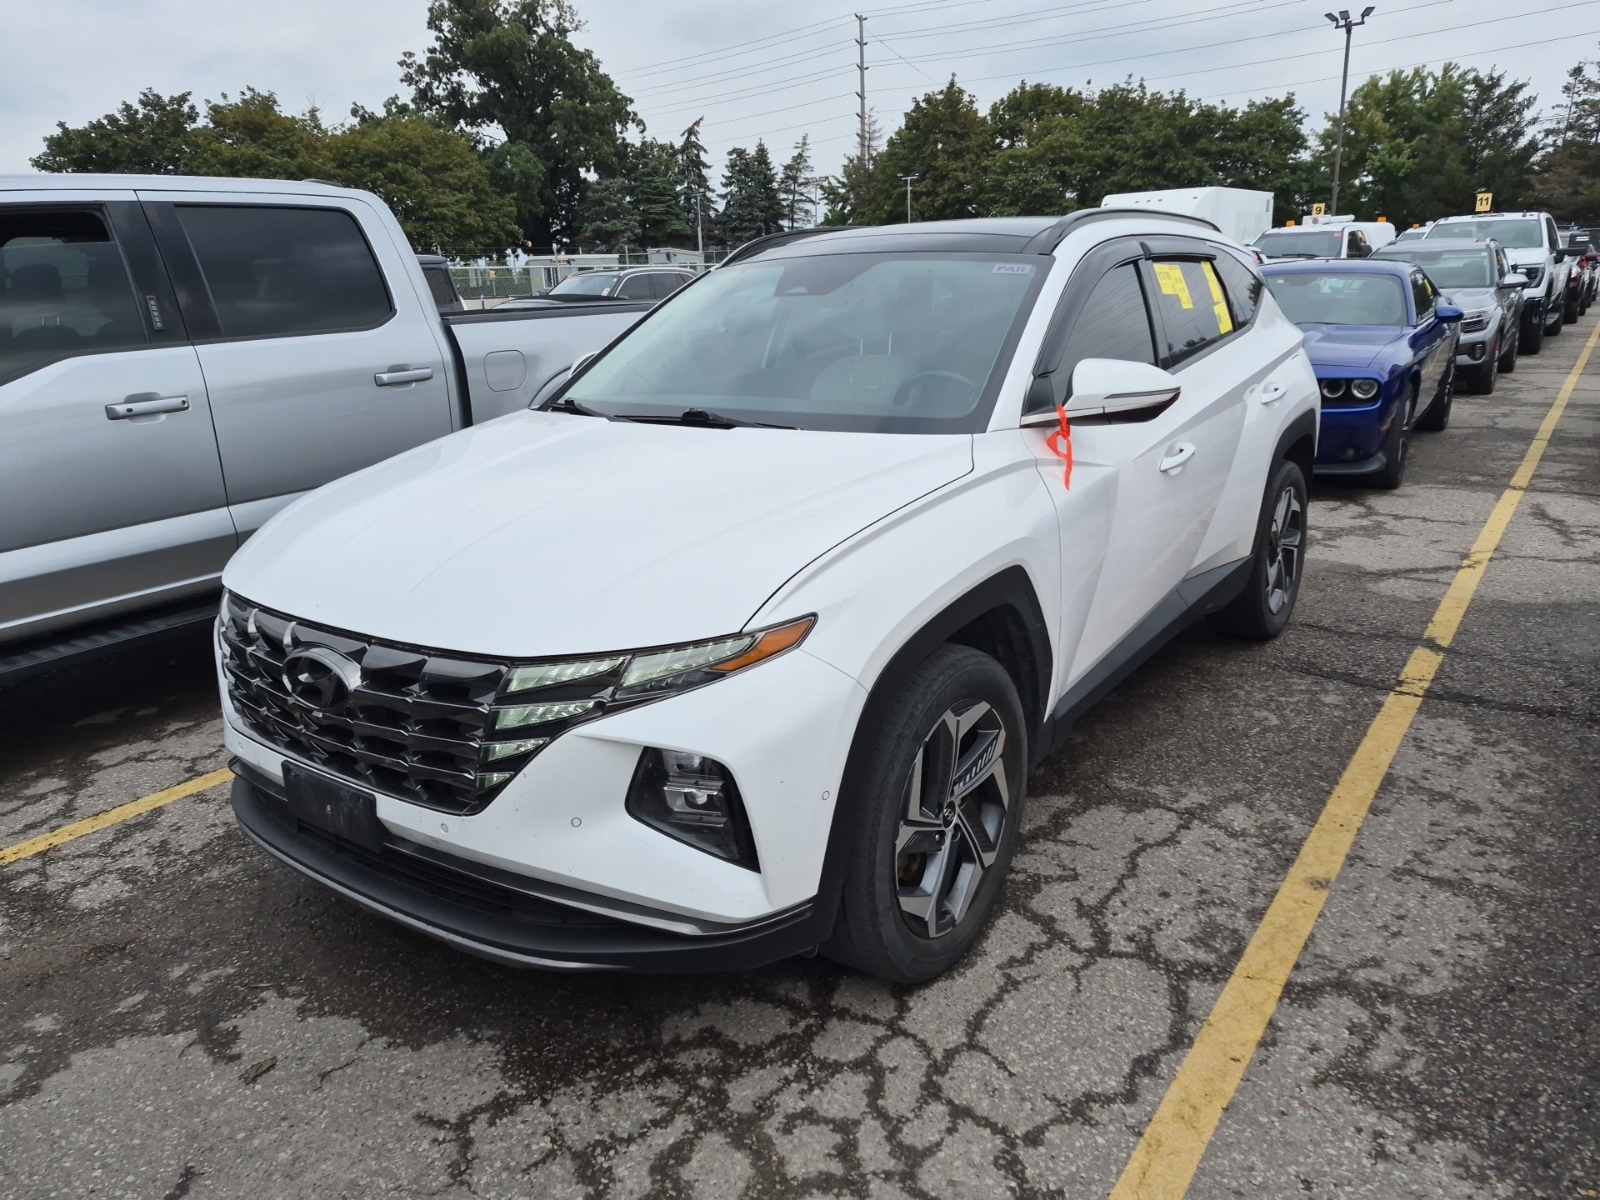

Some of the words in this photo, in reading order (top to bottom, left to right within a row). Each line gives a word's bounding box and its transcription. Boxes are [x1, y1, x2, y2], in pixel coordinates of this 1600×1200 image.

[1478, 197, 1489, 206] 11
[1315, 206, 1322, 215] 9
[997, 265, 1026, 273] PAR
